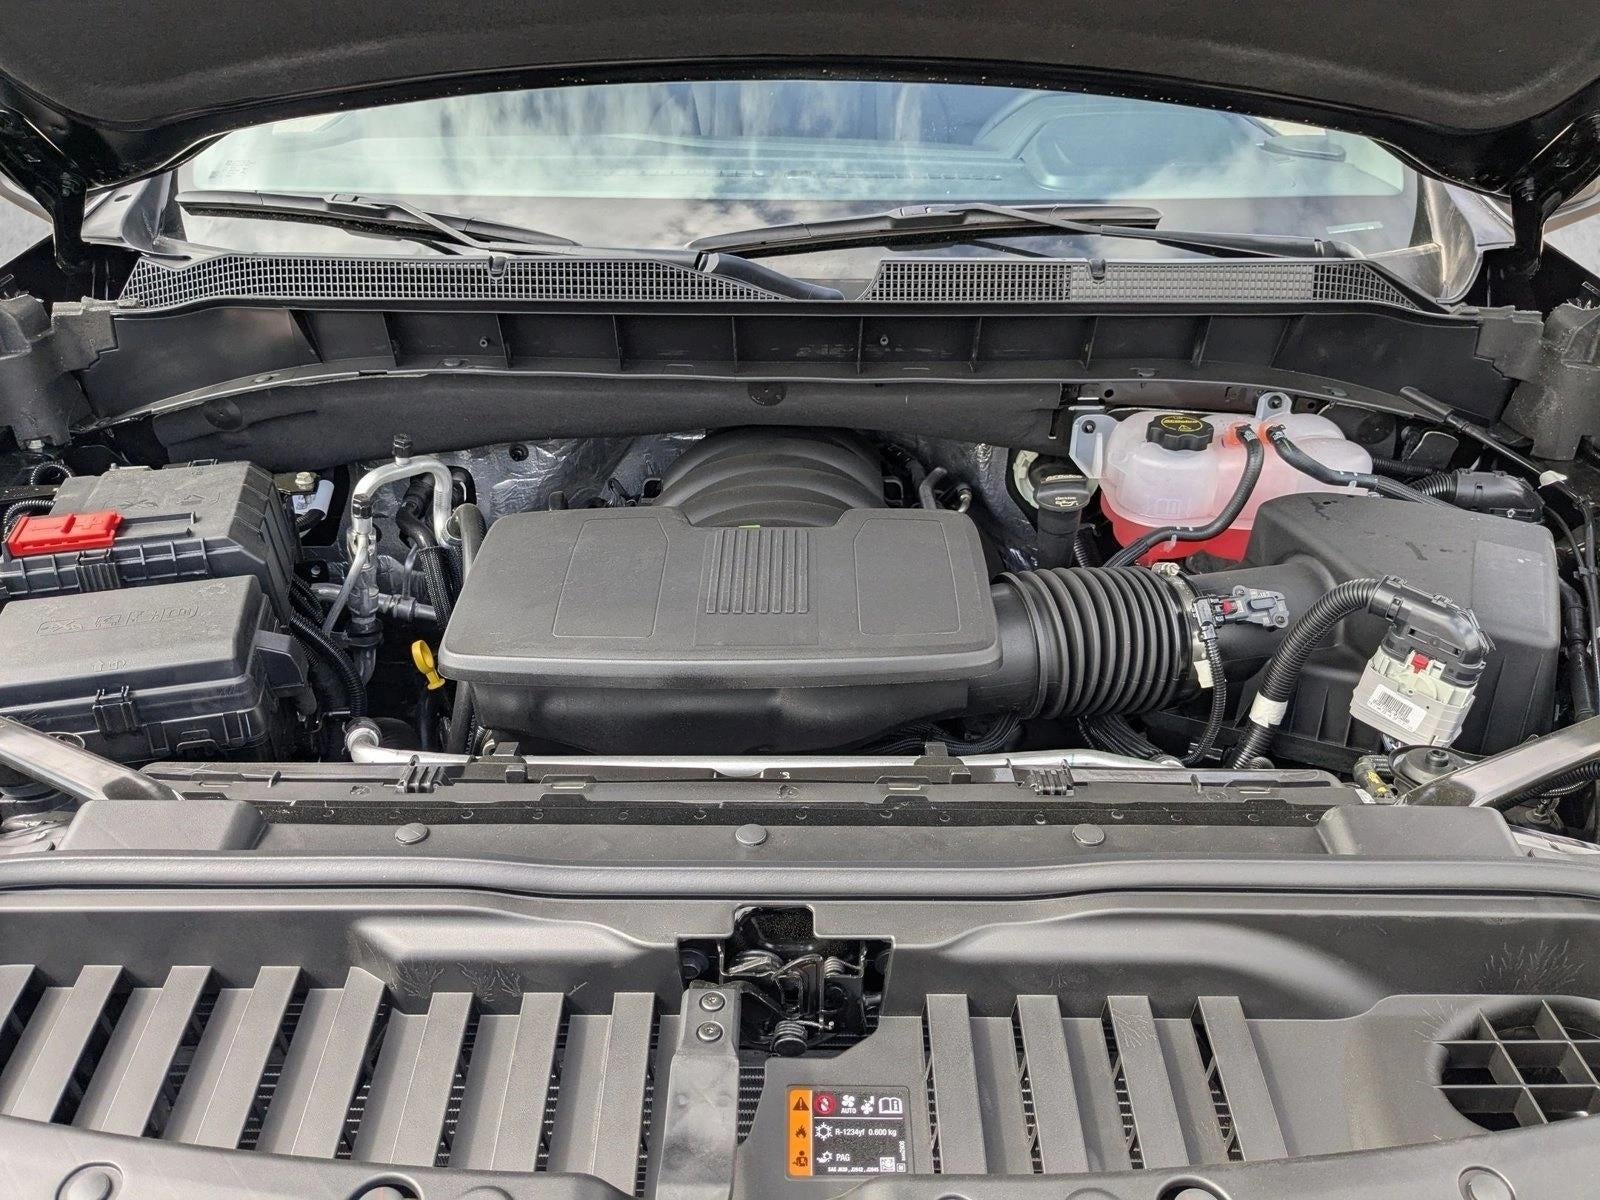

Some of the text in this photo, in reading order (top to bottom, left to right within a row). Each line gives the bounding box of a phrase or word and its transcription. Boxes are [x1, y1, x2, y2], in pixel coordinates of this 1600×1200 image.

[835, 1128, 897, 1138] R-1234yf 0.600 kg
[835, 1153, 850, 1162] PAG
